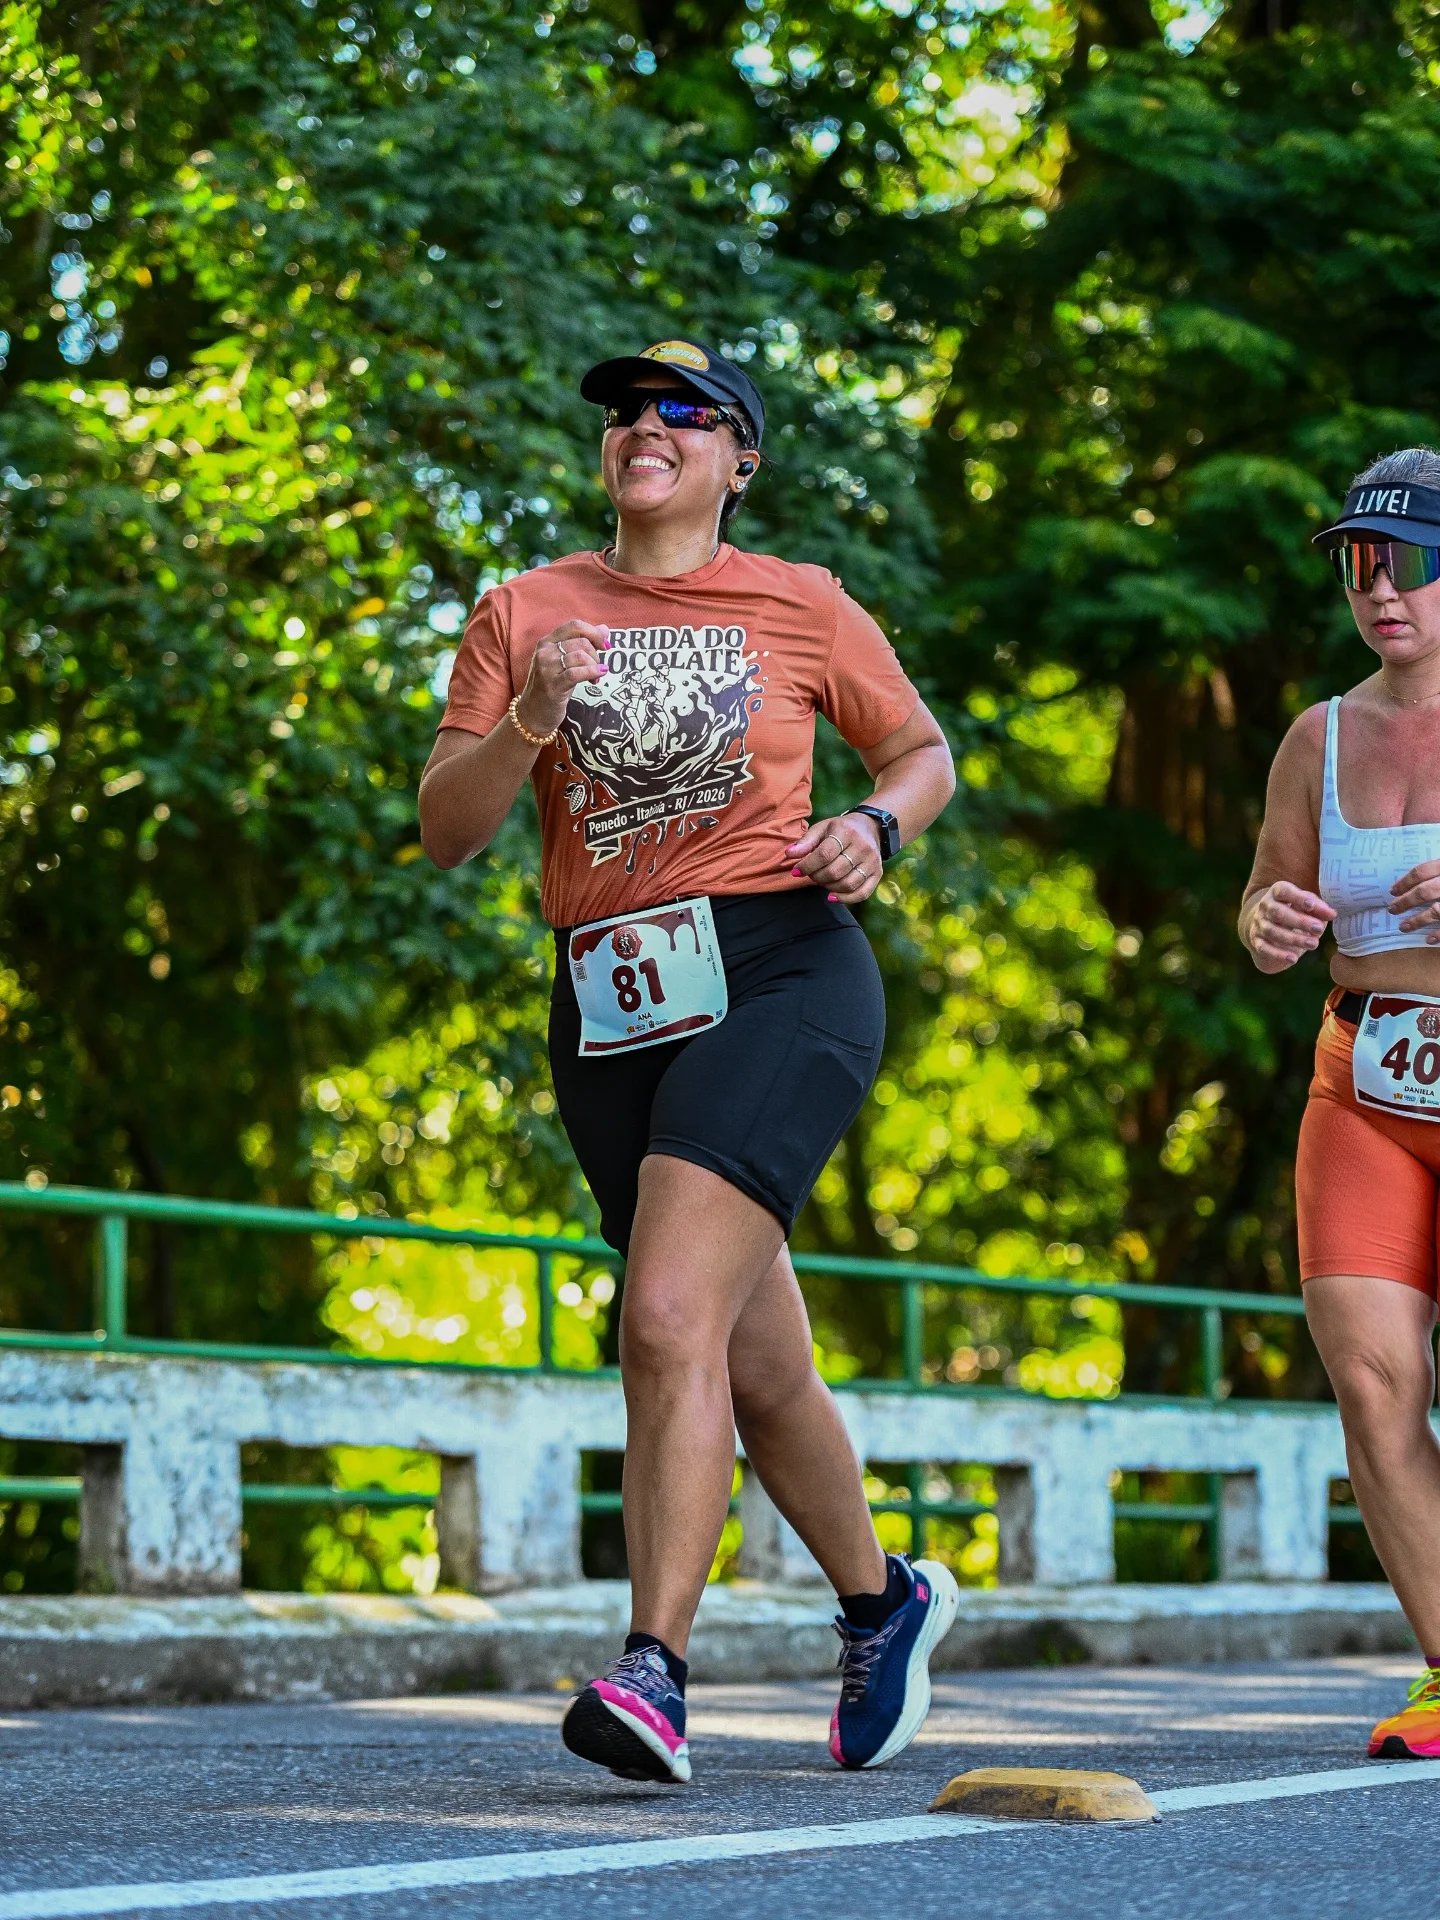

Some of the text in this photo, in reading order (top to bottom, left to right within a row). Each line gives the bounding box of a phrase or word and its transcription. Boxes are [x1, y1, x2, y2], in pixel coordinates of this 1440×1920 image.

[1354, 490, 1410, 515] LIVE!
[609, 628, 744, 650] RRIDA DO
[598, 649, 741, 677] OCOLATE
[588, 813, 628, 836] Penedo
[696, 787, 726, 804] 2026
[1351, 837, 1397, 856] LIVE!
[611, 957, 667, 1013] 81
[637, 1012, 652, 1020] ANA
[1380, 1037, 1440, 1085] 40
[1404, 1086, 1435, 1096] DANIELA
